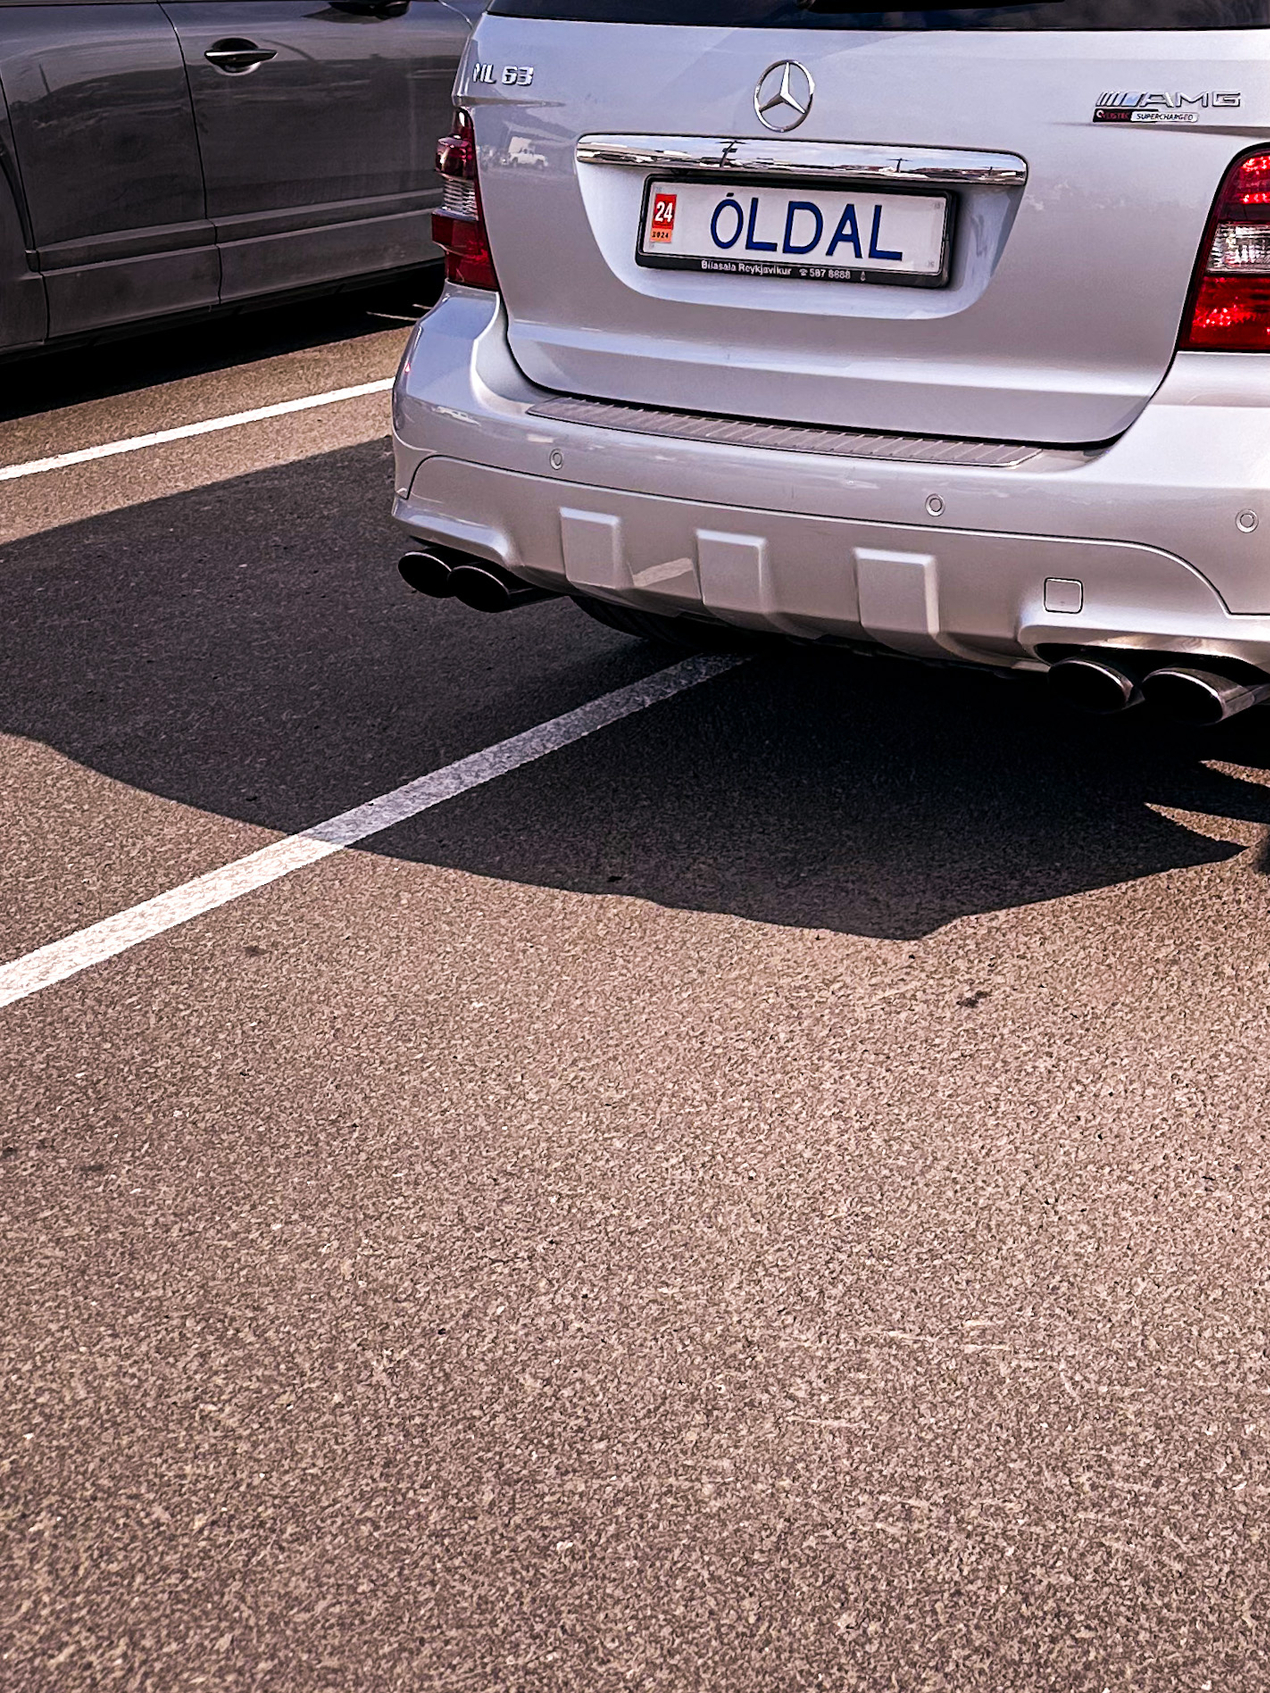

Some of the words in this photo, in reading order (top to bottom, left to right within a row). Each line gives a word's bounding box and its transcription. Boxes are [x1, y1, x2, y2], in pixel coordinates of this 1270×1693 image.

[501, 65, 535, 87] 63
[1139, 90, 1242, 108] AMG
[1135, 112, 1195, 122] SUPERCHARGED
[654, 200, 674, 223] 24
[710, 192, 903, 261] ÓLDAL
